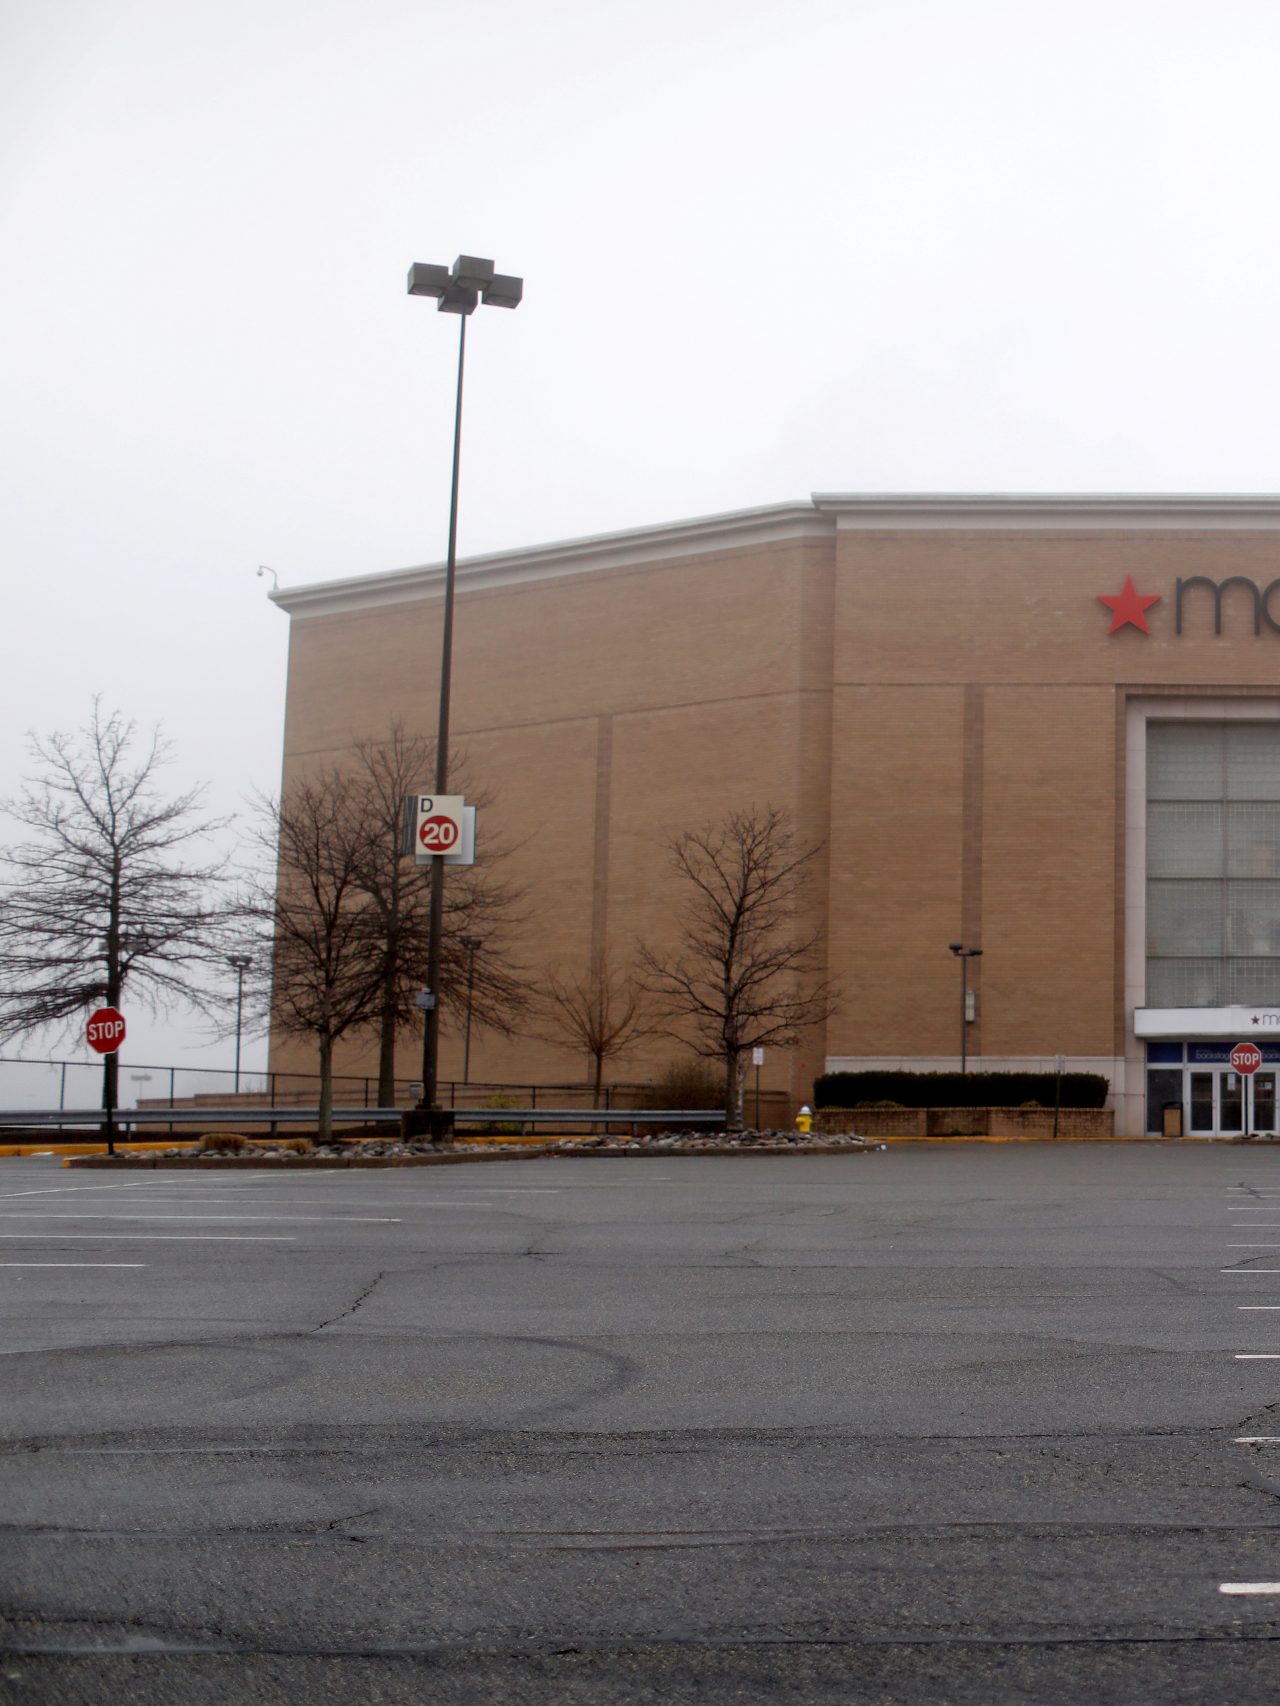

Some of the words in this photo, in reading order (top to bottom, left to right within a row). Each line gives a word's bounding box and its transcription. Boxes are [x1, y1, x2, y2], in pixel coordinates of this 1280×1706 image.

[421, 798, 433, 812] D
[423, 822, 455, 845] 20
[88, 1020, 123, 1041] STOP
[1196, 1051, 1230, 1061] backstag
[1232, 1053, 1259, 1066] STOP
